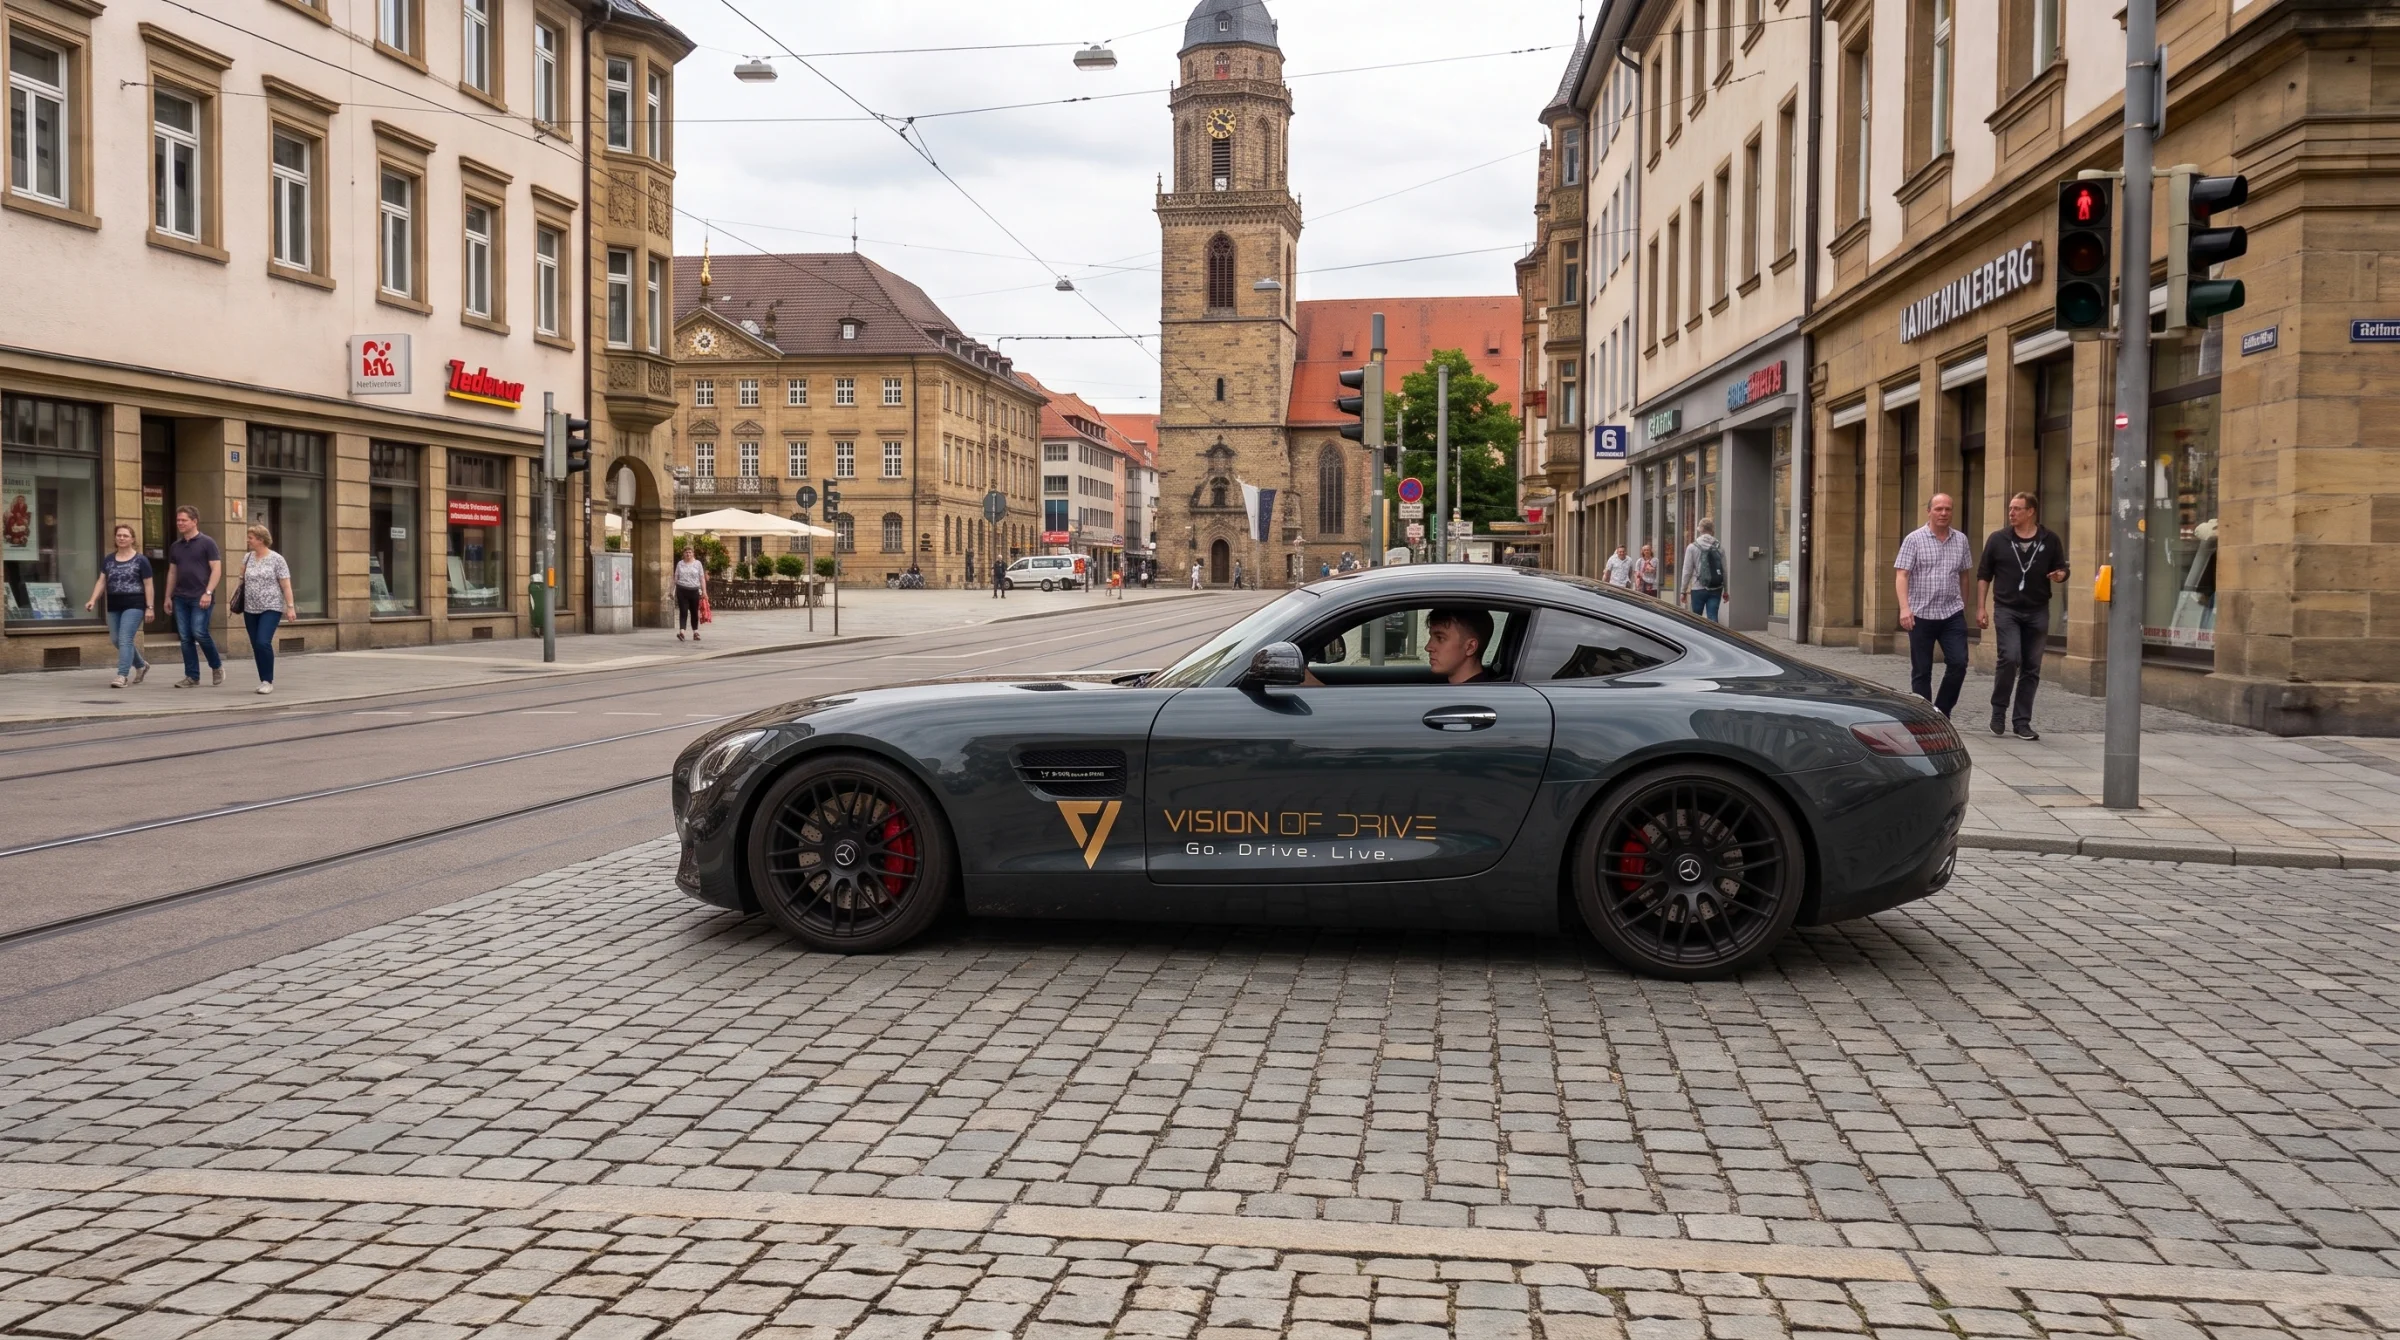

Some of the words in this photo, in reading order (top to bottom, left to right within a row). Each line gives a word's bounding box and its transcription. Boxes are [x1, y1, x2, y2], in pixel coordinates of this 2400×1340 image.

[1163, 809, 1270, 835] VISION
[1280, 811, 1324, 836] OF
[1336, 812, 1438, 841] DRIVE
[1185, 842, 1223, 856] Go.
[1238, 843, 1317, 859] Drive.
[1331, 846, 1395, 861] Live.
